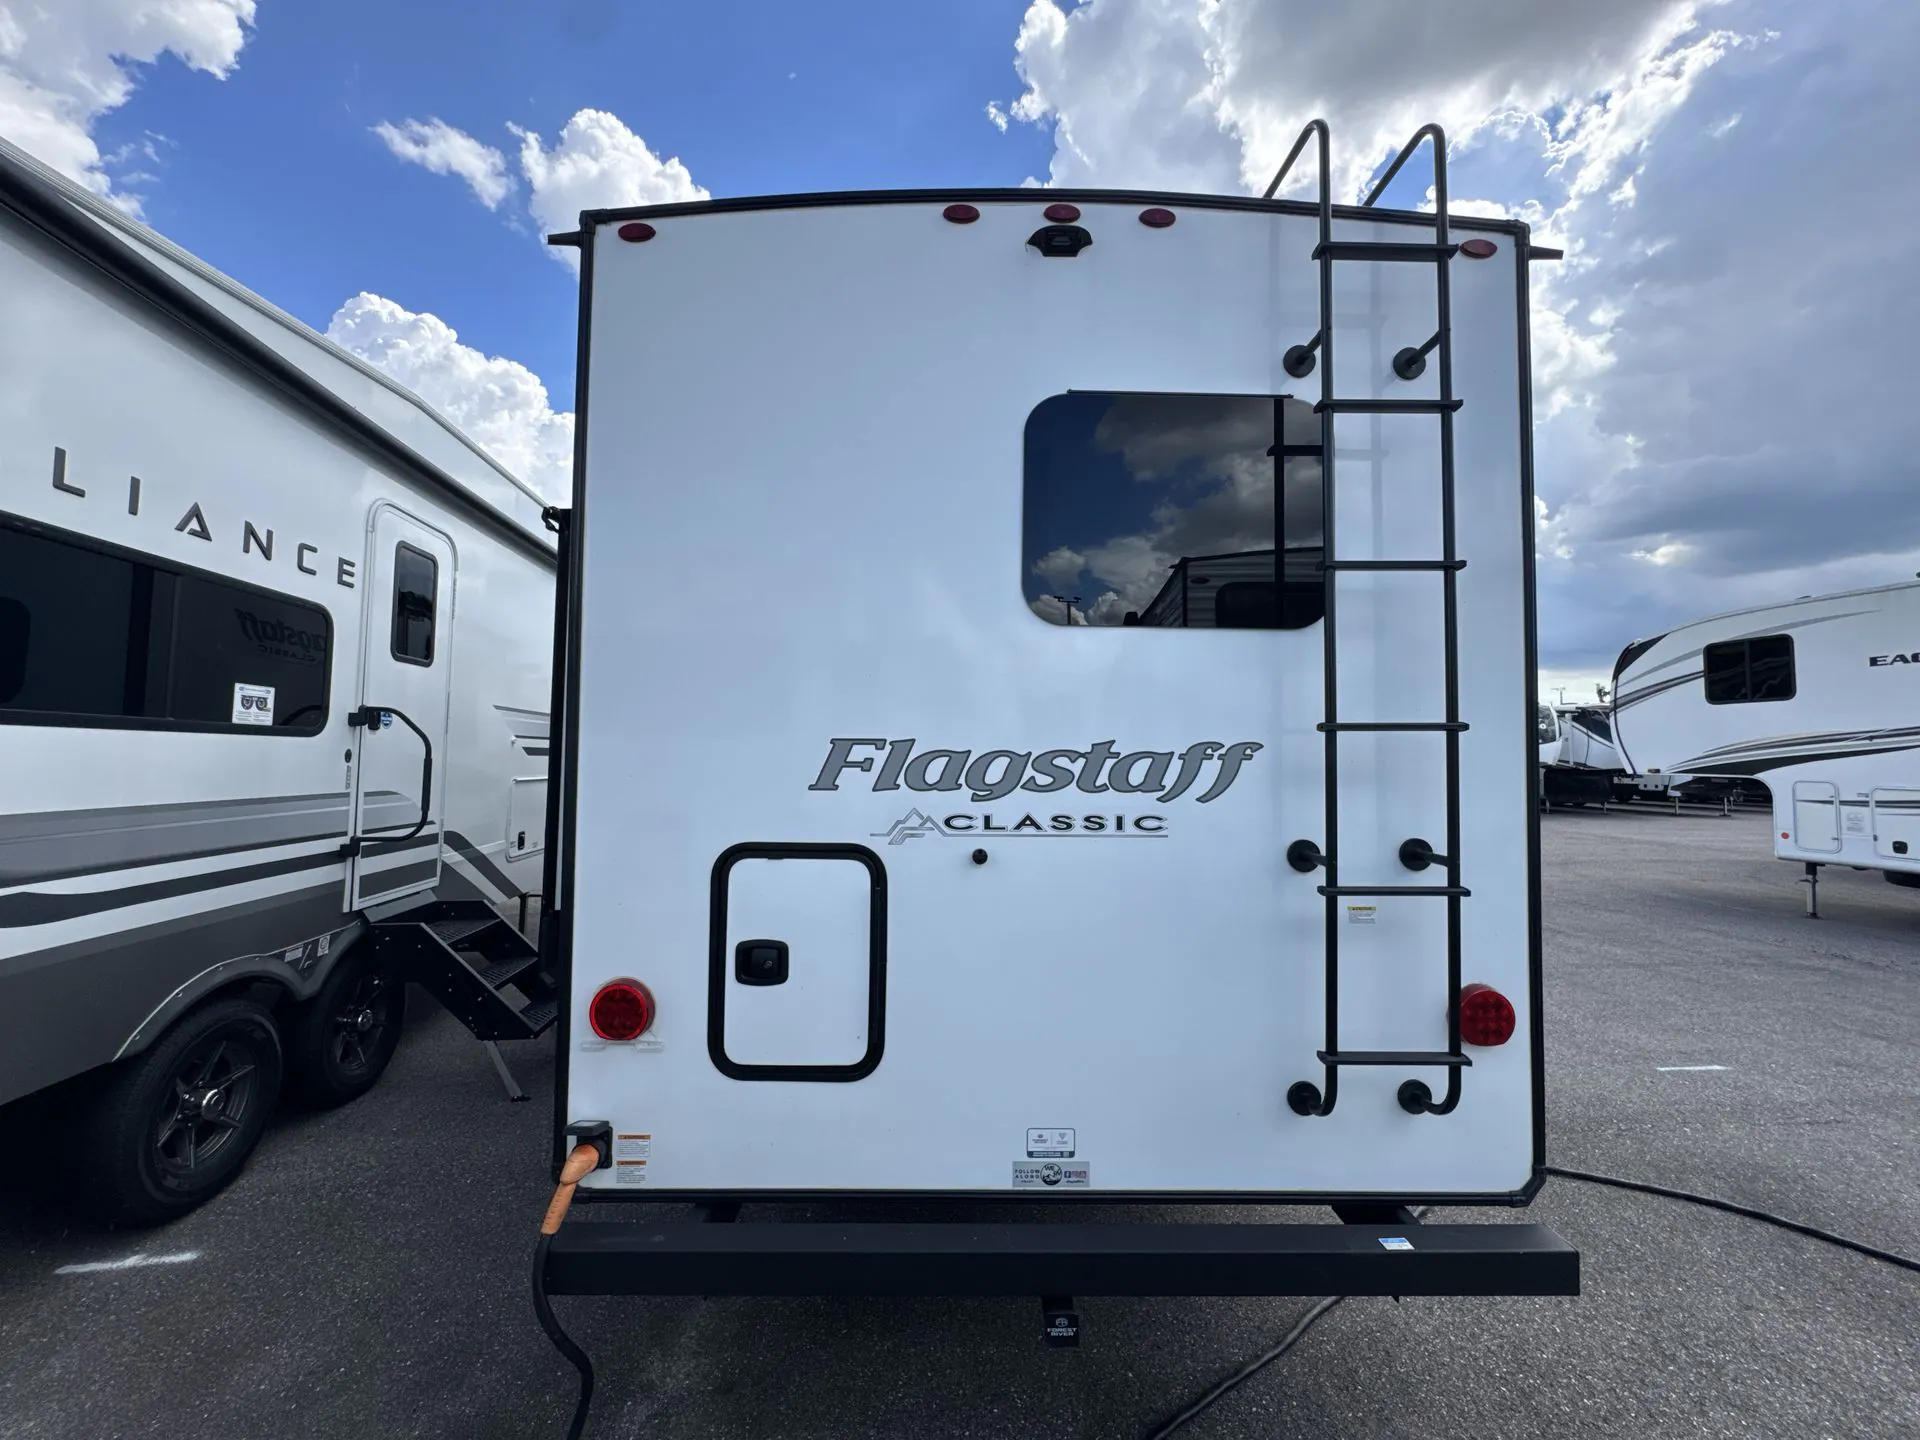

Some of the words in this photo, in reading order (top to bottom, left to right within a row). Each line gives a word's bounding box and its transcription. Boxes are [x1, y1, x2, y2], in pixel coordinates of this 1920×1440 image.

[52, 446, 356, 589] LIANCE
[808, 738, 1264, 803] Flagstaff
[942, 811, 1169, 833] CLASSIC
